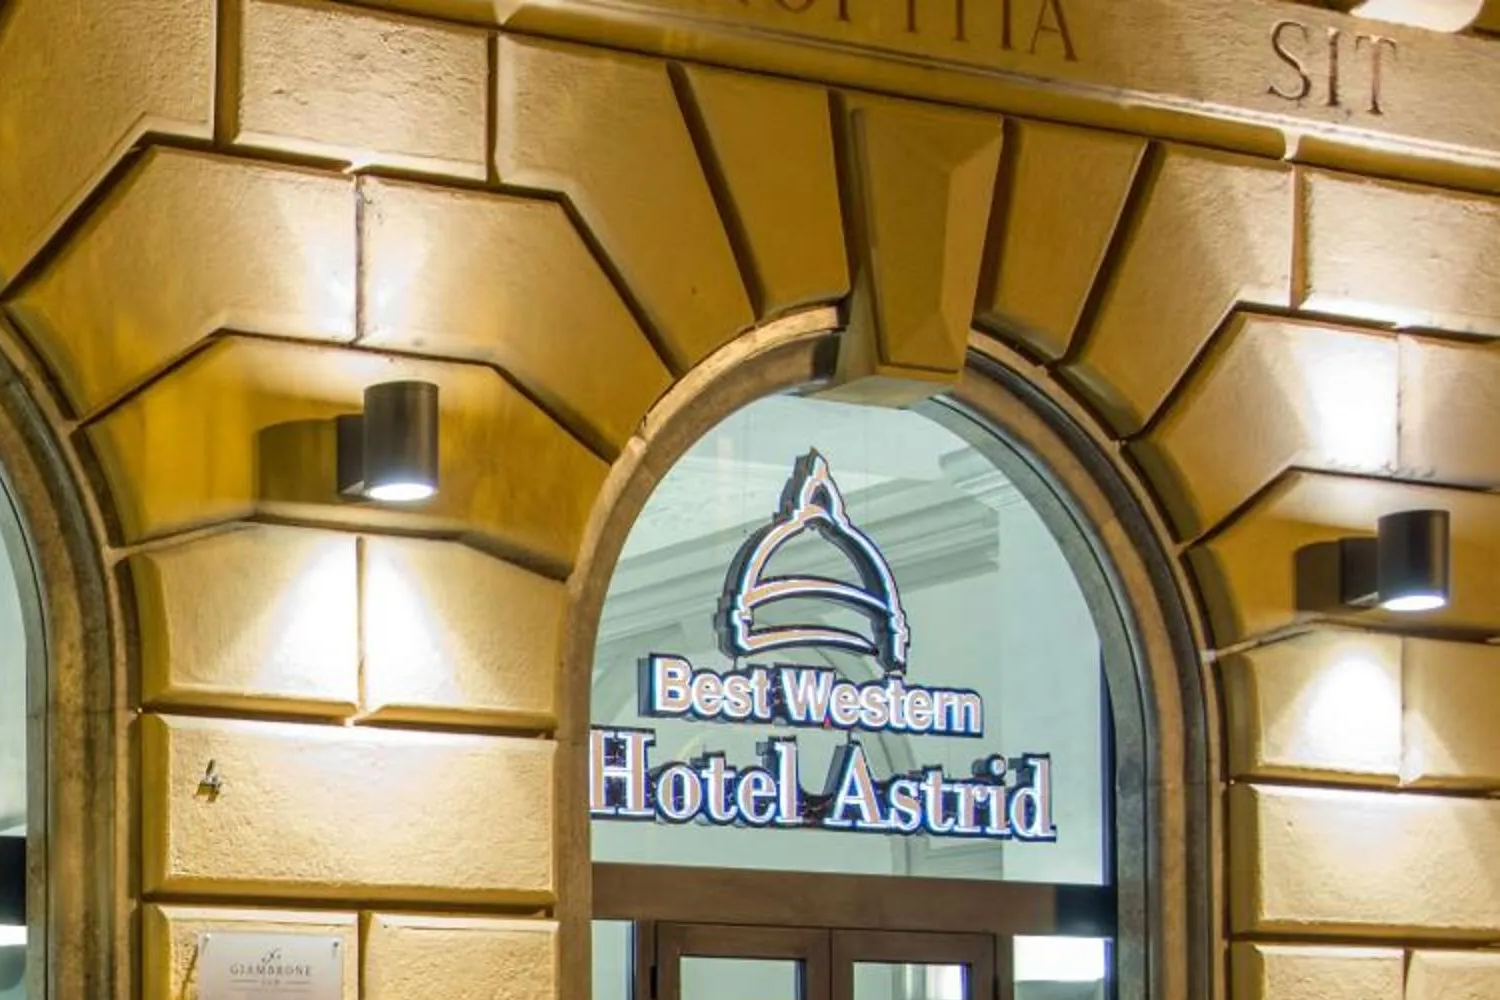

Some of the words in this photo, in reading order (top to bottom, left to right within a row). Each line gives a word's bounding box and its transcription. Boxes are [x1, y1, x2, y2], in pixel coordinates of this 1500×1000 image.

[1267, 19, 1398, 115] SIT
[652, 656, 771, 719] Best
[778, 667, 984, 735] Western
[590, 729, 802, 826] Hotel
[825, 742, 1056, 839] Astrid
